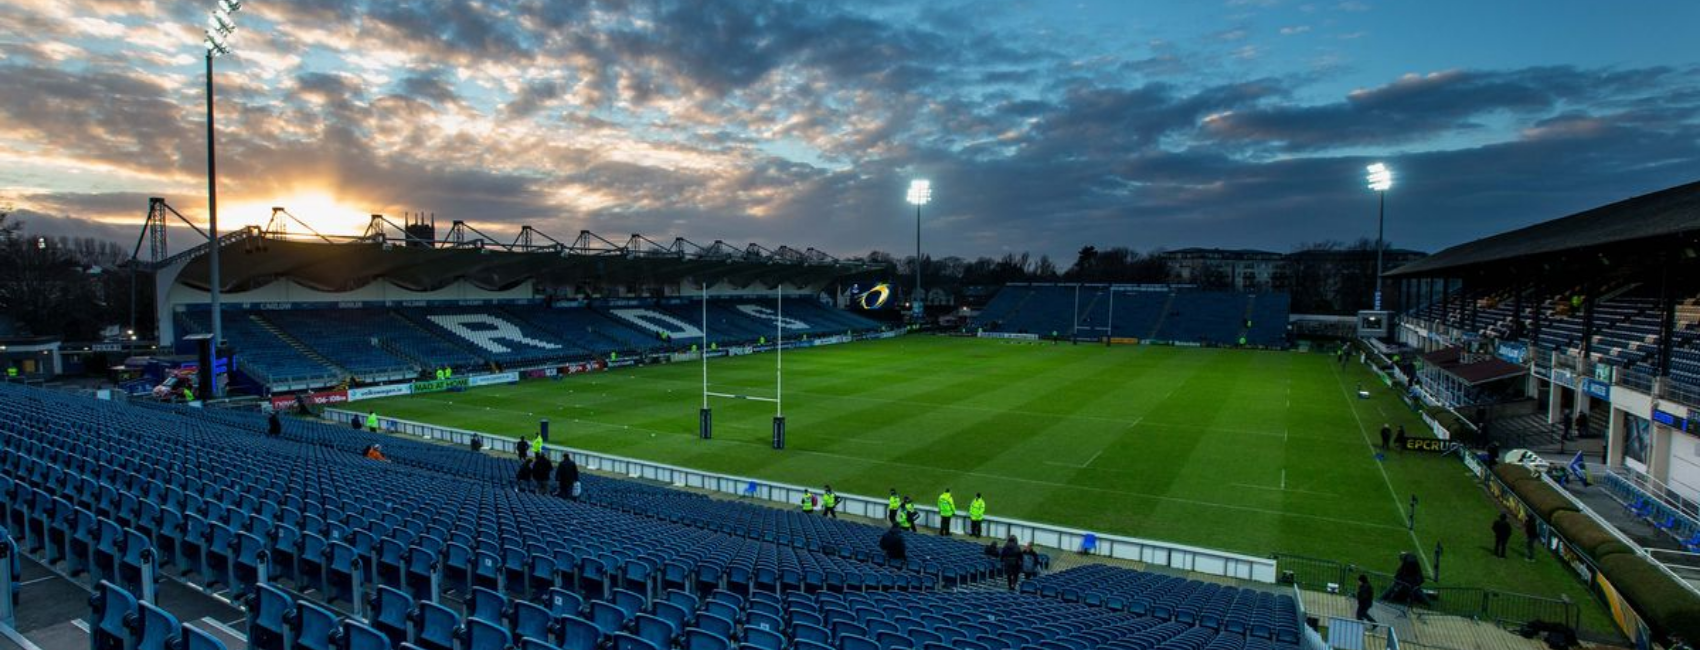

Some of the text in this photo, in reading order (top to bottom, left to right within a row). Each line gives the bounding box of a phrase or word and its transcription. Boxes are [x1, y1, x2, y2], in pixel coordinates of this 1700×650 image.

[260, 303, 292, 311] CARLOW
[427, 304, 811, 352] RDS
[416, 378, 468, 391] MAD AT HOME
[362, 386, 402, 396] volkswagen.ie
